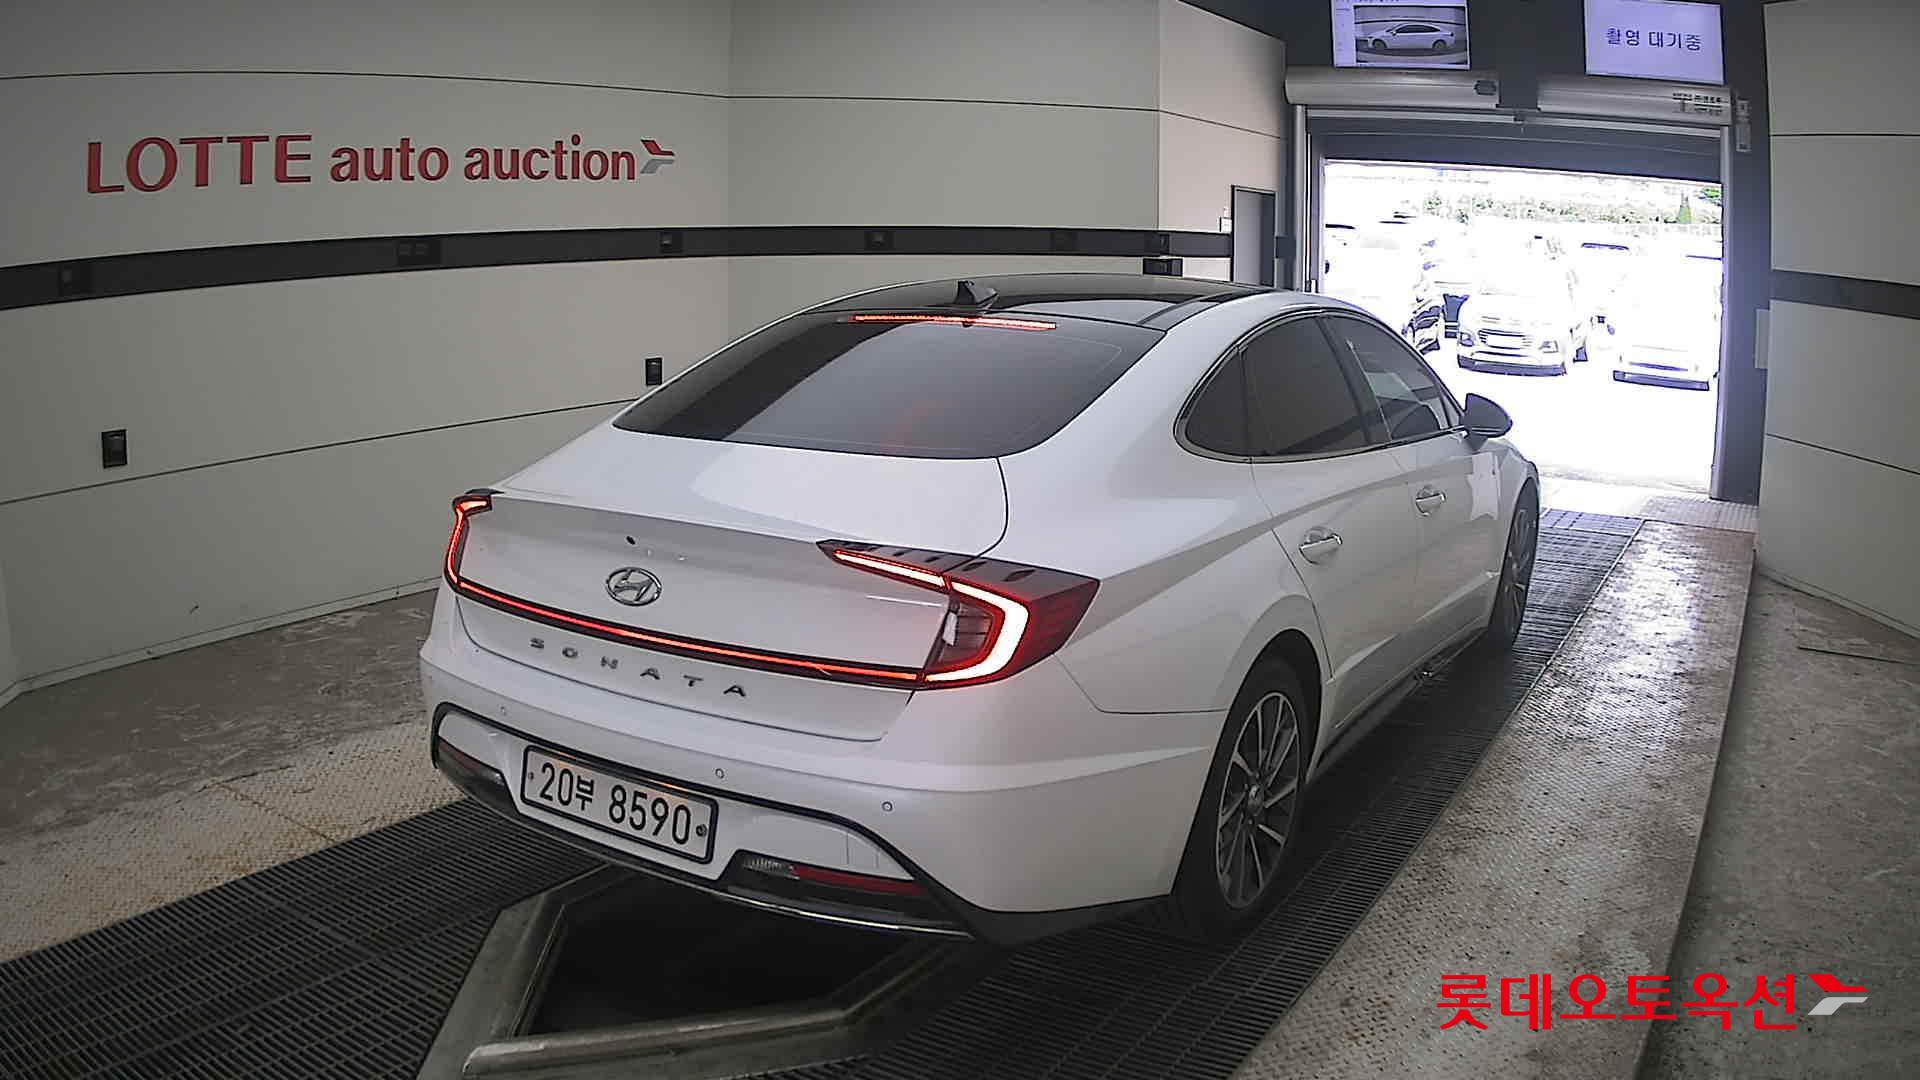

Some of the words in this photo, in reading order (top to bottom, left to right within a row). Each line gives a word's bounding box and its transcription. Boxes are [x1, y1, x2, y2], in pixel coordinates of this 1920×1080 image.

[1648, 31, 1701, 51] 대기중
[86, 134, 312, 194] LOTTE
[329, 136, 450, 183] auto
[463, 133, 637, 182] auction
[530, 637, 747, 698] SONATA
[539, 762, 595, 811] 20부
[608, 784, 692, 845] 8590
